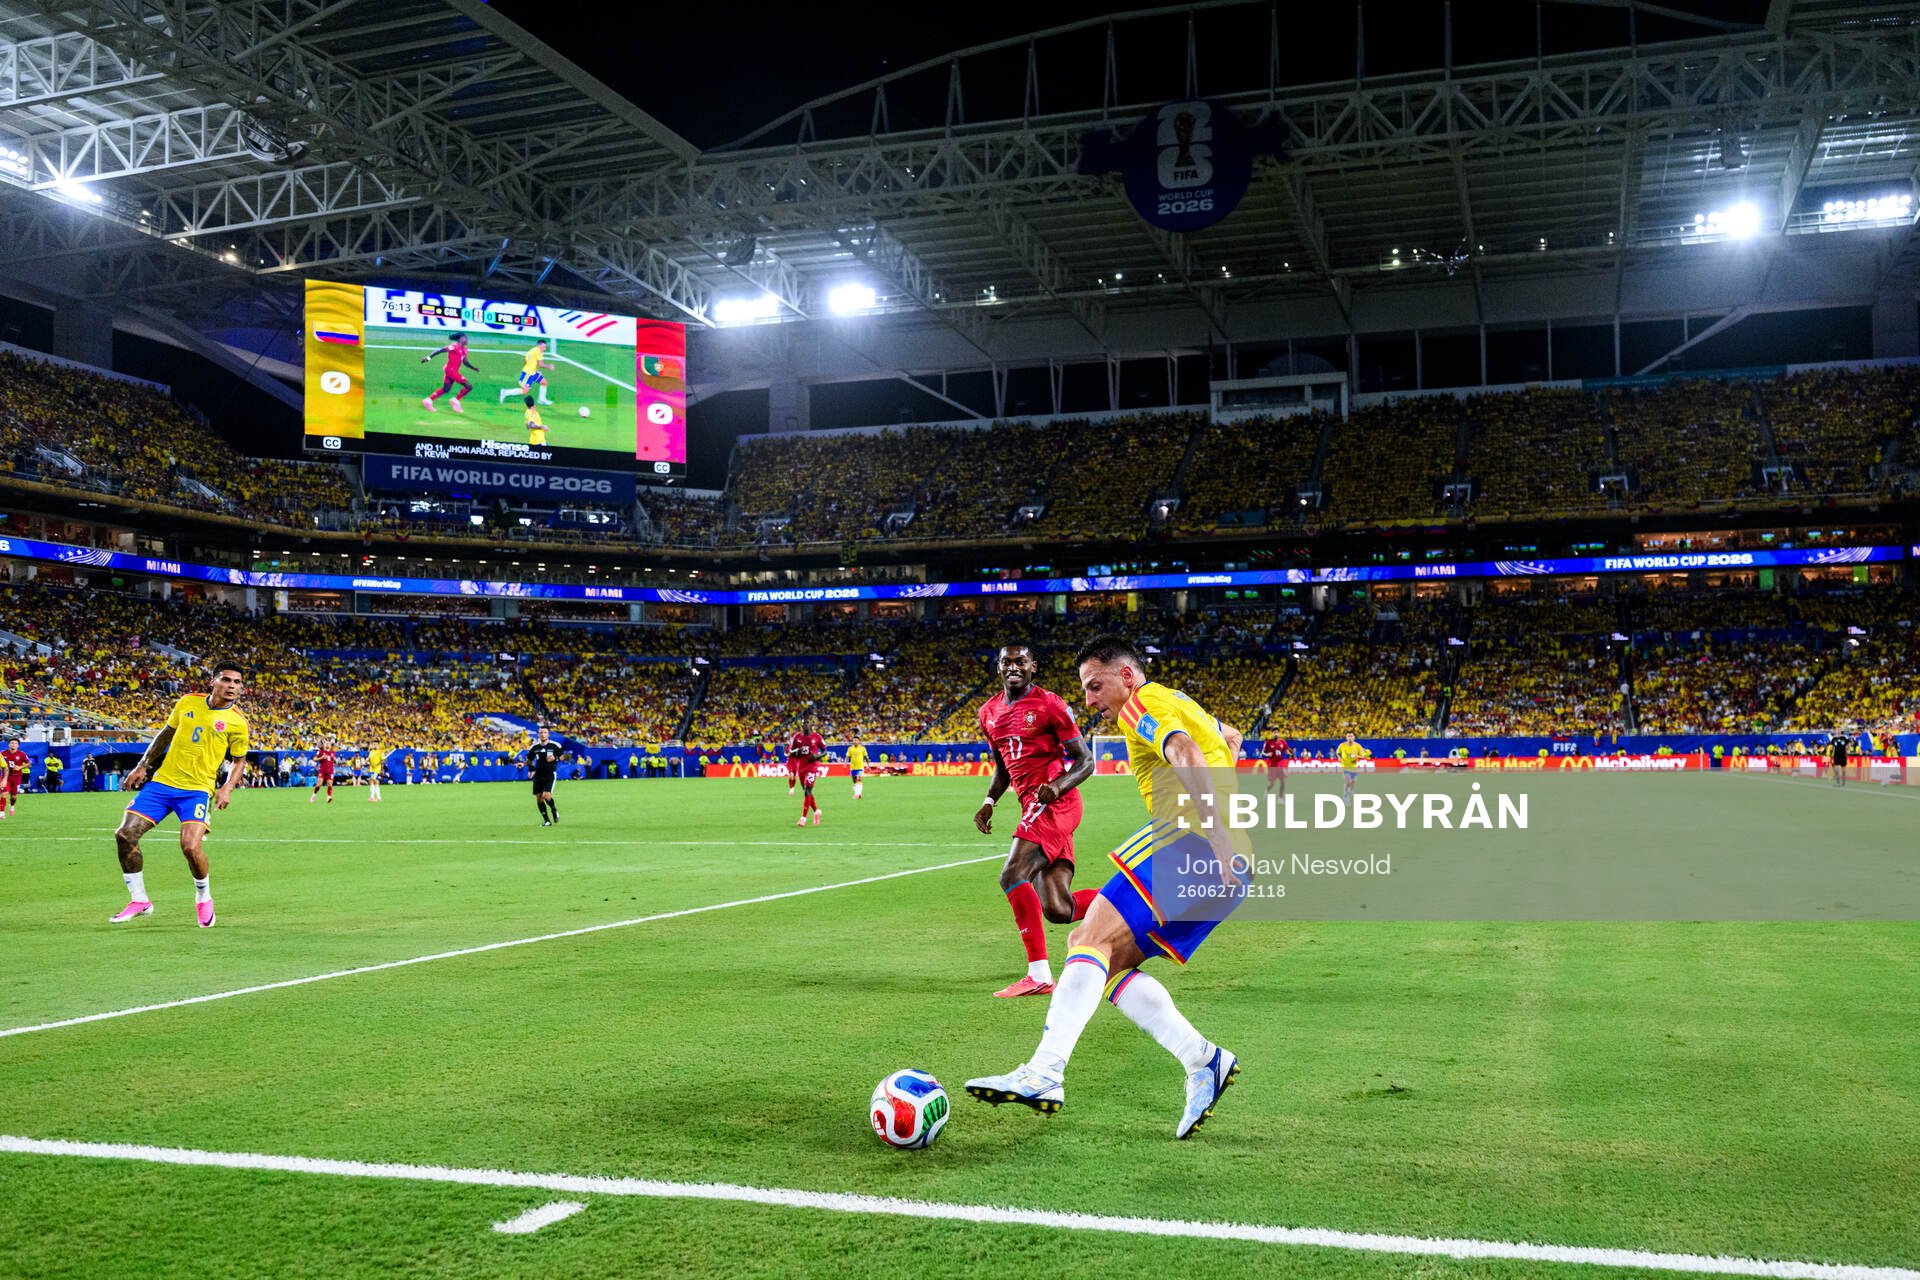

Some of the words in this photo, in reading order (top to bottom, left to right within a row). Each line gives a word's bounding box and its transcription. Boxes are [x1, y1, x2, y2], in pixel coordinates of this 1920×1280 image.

[1173, 169, 1199, 181] FIFA
[1158, 190, 1192, 201] WORLD
[1195, 189, 1214, 199] CUP
[1157, 199, 1214, 215] 2026
[381, 300, 412, 313] 76:13
[443, 306, 459, 318] COL
[324, 438, 340, 448] CC
[480, 439, 530, 452] Hisense
[415, 443, 433, 452] AND
[447, 445, 470, 455] JHON
[470, 447, 497, 457] ARIAS,
[498, 449, 540, 460] REPLACED
[541, 452, 553, 461] BY
[424, 450, 450, 459] KEVIN
[655, 463, 670, 473] CC
[391, 465, 433, 482] FIFA
[436, 468, 505, 487] WORLD
[509, 473, 546, 489] CUP
[549, 476, 613, 494] 2026
[146, 560, 182, 574] MIAMI
[1605, 558, 1633, 569] FIFA
[1633, 556, 1680, 568] WORLD
[1680, 555, 1706, 567] CUP
[1707, 553, 1753, 566] 2026
[1414, 565, 1456, 577] MIAMI
[585, 587, 623, 598] MIAMI
[981, 581, 1018, 593] MIAMI
[748, 591, 769, 602] FIFA
[769, 590, 804, 601] WORLD
[804, 589, 825, 600] CUP
[825, 588, 860, 599] 2026
[191, 726, 204, 742] 6
[1006, 735, 1023, 760] 17
[1553, 742, 1578, 752] FIFA
[912, 762, 935, 776] Big
[937, 762, 972, 776] Mac?
[1475, 757, 1500, 773] Big
[1503, 757, 1545, 772] Mac?
[1595, 756, 1687, 771] McDelivery
[194, 803, 206, 819] 6
